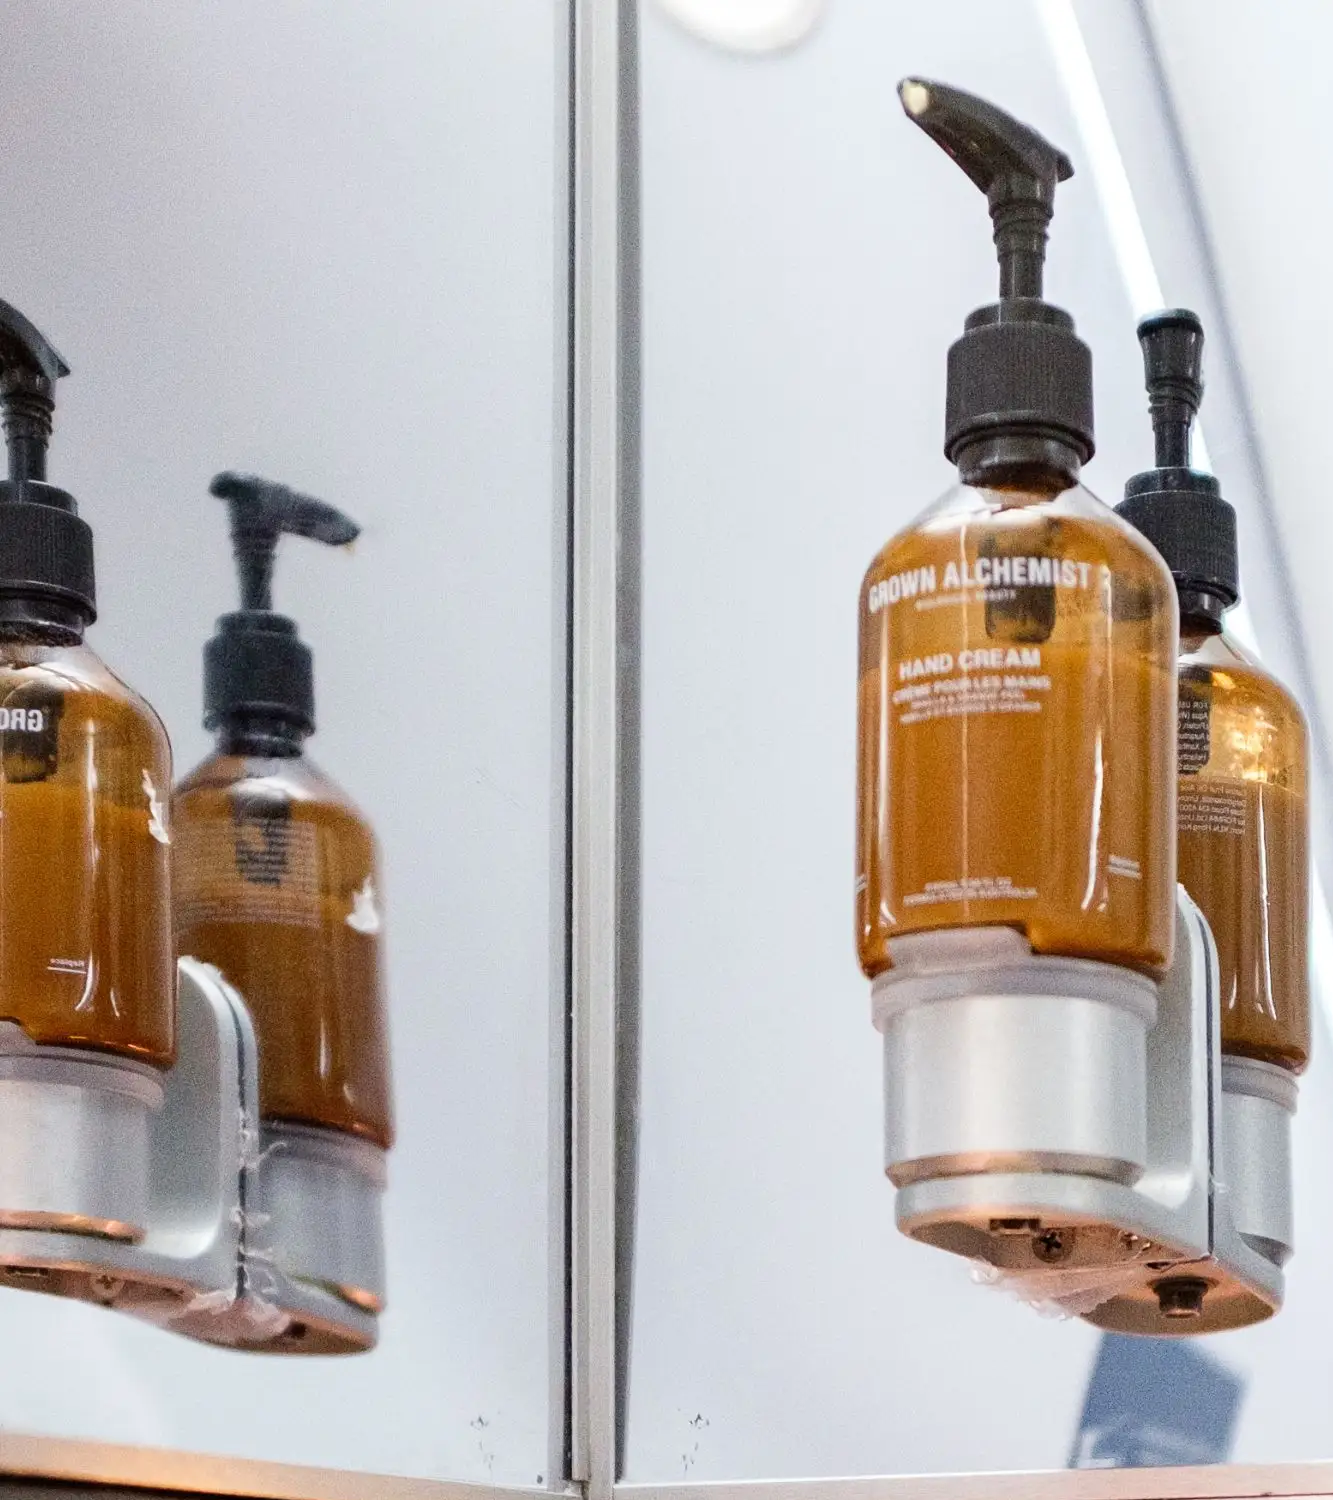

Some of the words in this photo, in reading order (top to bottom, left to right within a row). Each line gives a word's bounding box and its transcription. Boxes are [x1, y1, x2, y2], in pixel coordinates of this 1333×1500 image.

[868, 563, 937, 614] GROWN
[943, 556, 1092, 590] ALCHEMIST
[899, 652, 954, 681] HAND
[957, 646, 1041, 670] CREAM
